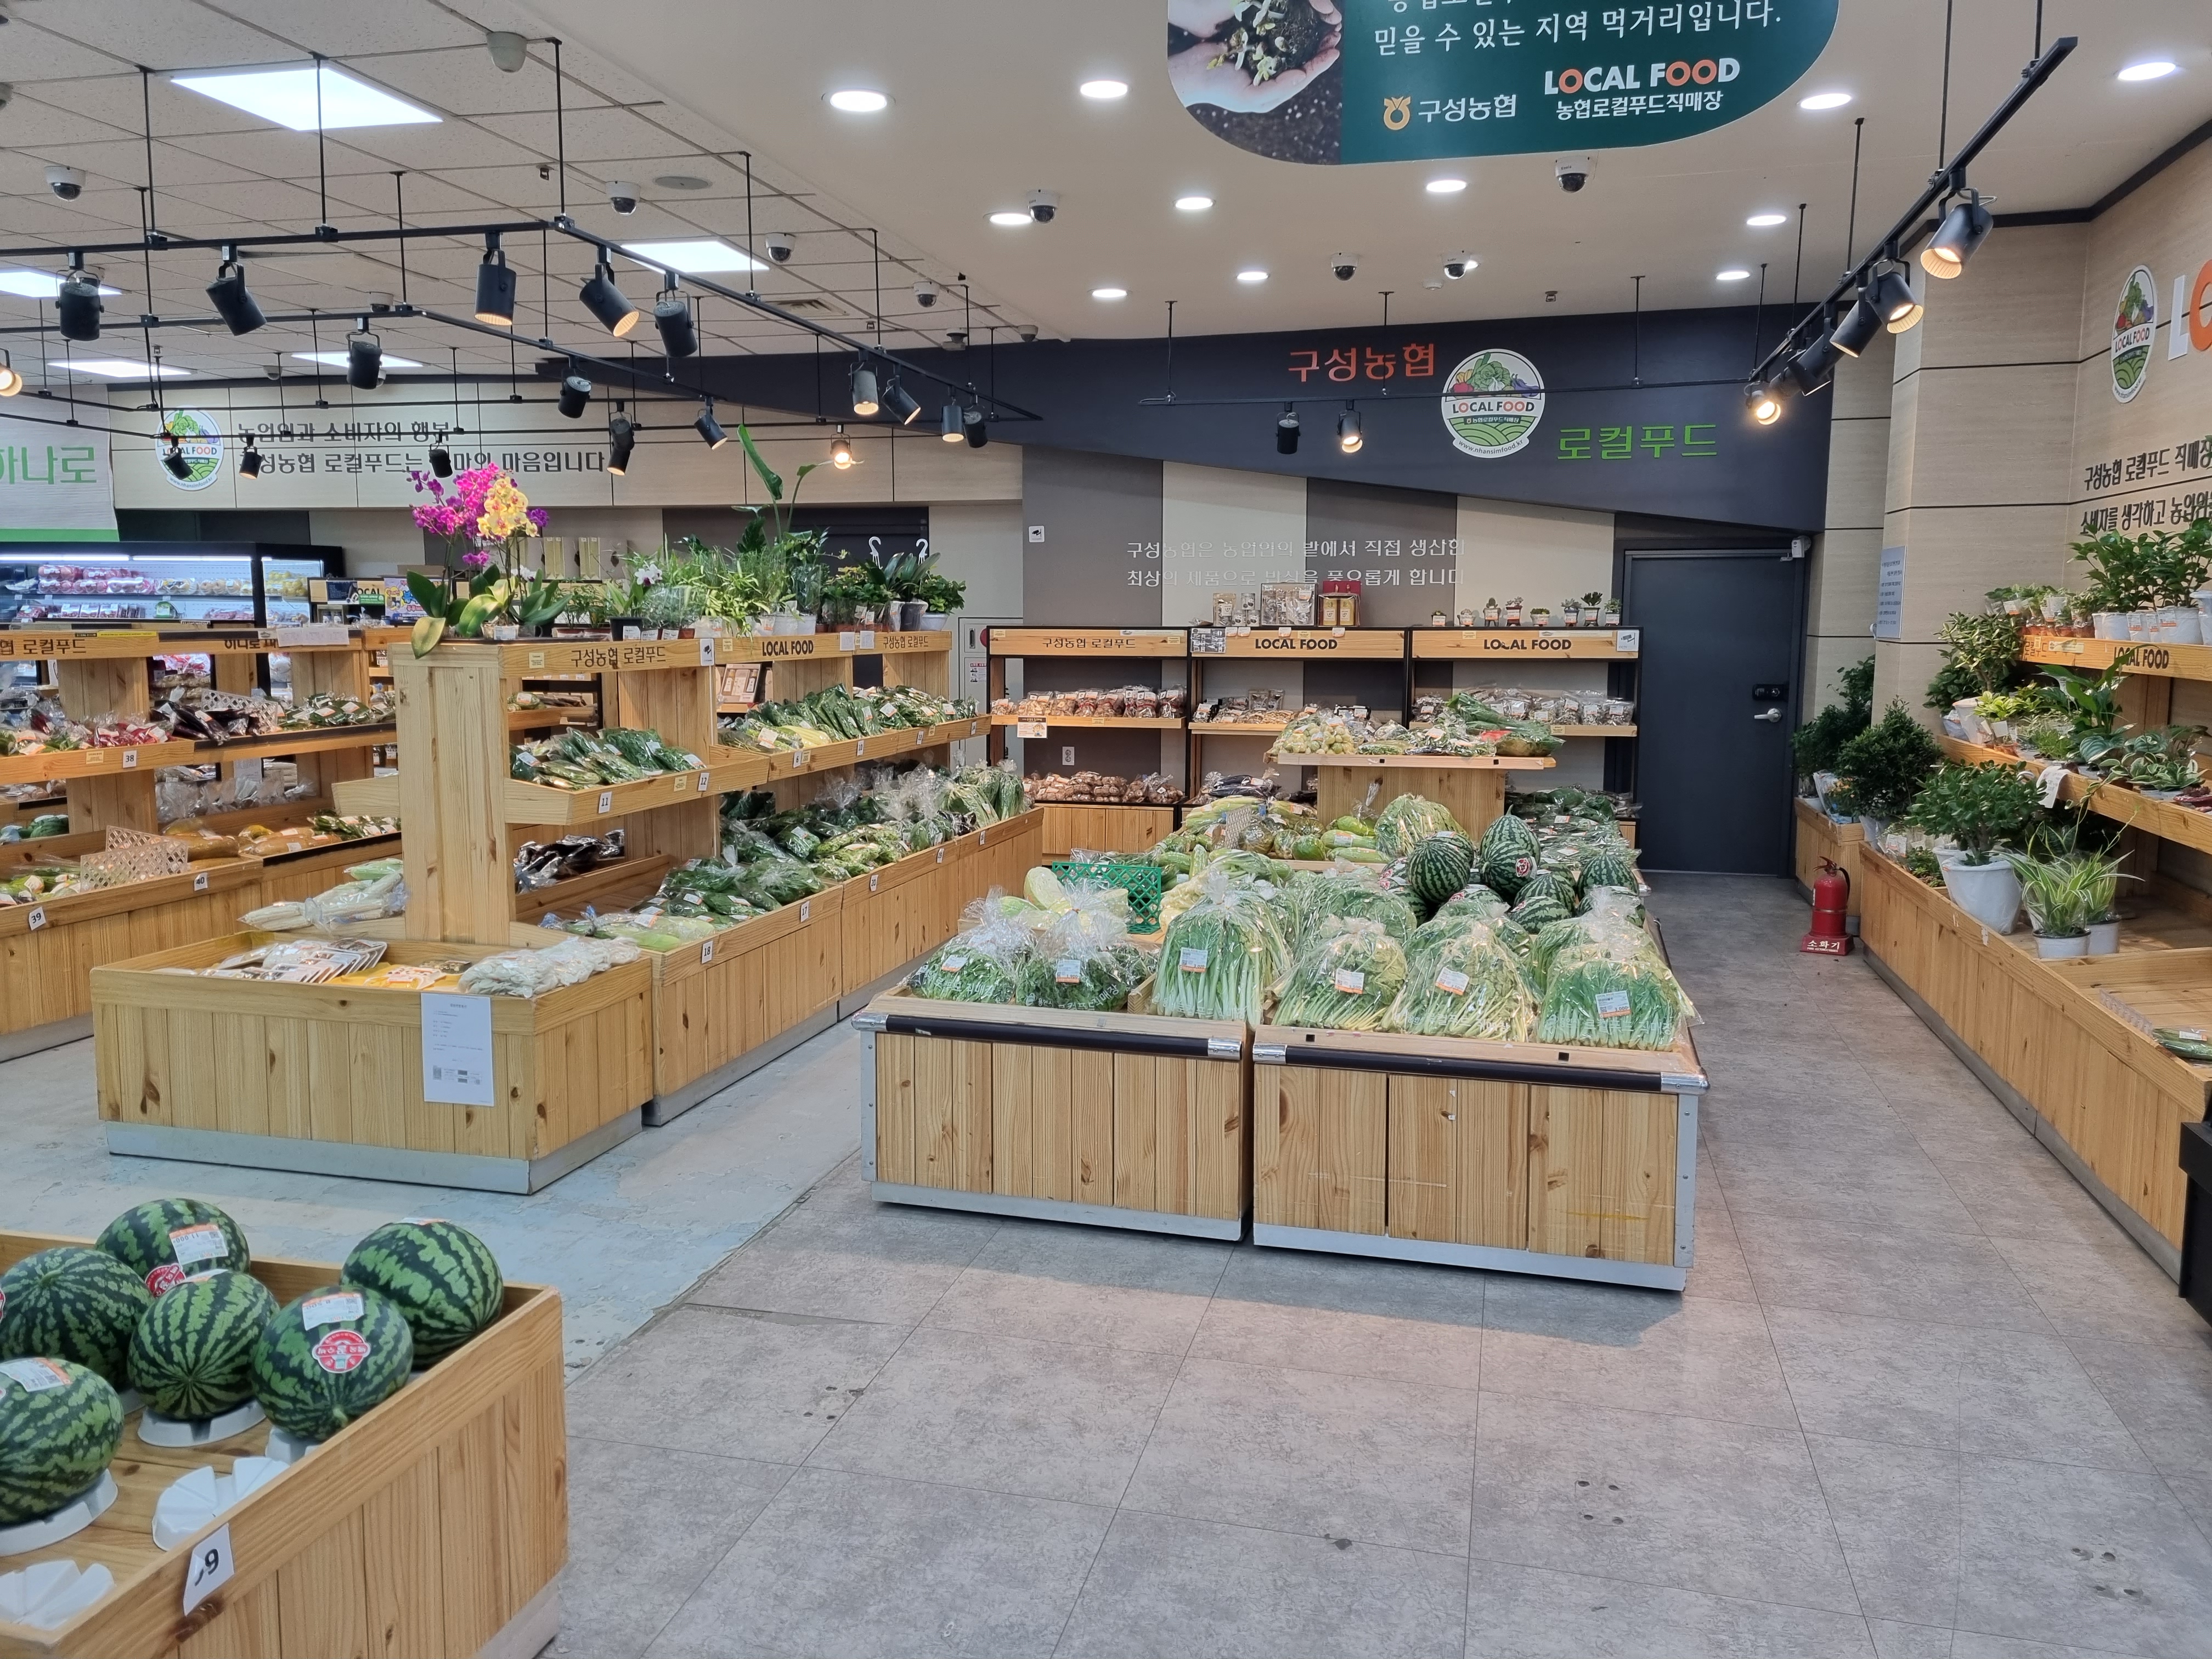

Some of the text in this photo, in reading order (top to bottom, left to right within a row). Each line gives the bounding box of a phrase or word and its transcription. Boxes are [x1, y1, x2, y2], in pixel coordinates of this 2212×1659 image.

[1375, 0, 1781, 55] 믿을 수 있는 지역 먹거리입니다.
[1544, 58, 1740, 94] LOCAL FOOD
[1418, 94, 1516, 122] 구성농협
[1556, 91, 1724, 120] 농협로컬푸드직매장
[2115, 328, 2149, 353] LOCAL FOOD
[1289, 343, 1435, 382] 구성농협
[1453, 401, 1534, 414] LOCAL FOOD
[324, 422, 402, 442] 소비자의
[192, 446, 217, 455] FOOD
[1459, 439, 1523, 454] www.nhansimfood.kr
[1558, 425, 1717, 460] 로컬푸드
[239, 453, 315, 473] 성농협
[324, 453, 422, 473] 로컬푸드는
[502, 452, 605, 472] 마음입니다
[2084, 459, 2122, 491] 구성농협
[2125, 448, 2170, 482] 로컬푸드
[2121, 500, 2166, 531] 생각하고
[1127, 538, 1465, 558] 구성농협은 농업인의 밭에서 직접 생산한
[1127, 570, 1178, 587] 최상의
[1186, 570, 1256, 586] 제품으로
[1409, 568, 1464, 585] 합니다
[23, 639, 86, 655] 로컬푸드
[762, 640, 814, 657] LOCAL FOOD
[883, 635, 929, 649] 구성농협 로컬푸드
[1042, 637, 1136, 649] 구성농협 로컬푸드
[1255, 638, 1338, 650] LOCAL FOOD
[1532, 639, 1572, 650] FOOD
[571, 646, 666, 668] 구성농협 로컬푸드
[2142, 649, 2169, 669] FOOD
[700, 777, 707, 785] 12
[601, 797, 608, 806] 11
[196, 877, 205, 885] 40
[31, 912, 42, 923] 39
[802, 906, 808, 916] 17
[703, 946, 710, 957] 18
[1807, 940, 1840, 950] 소화기
